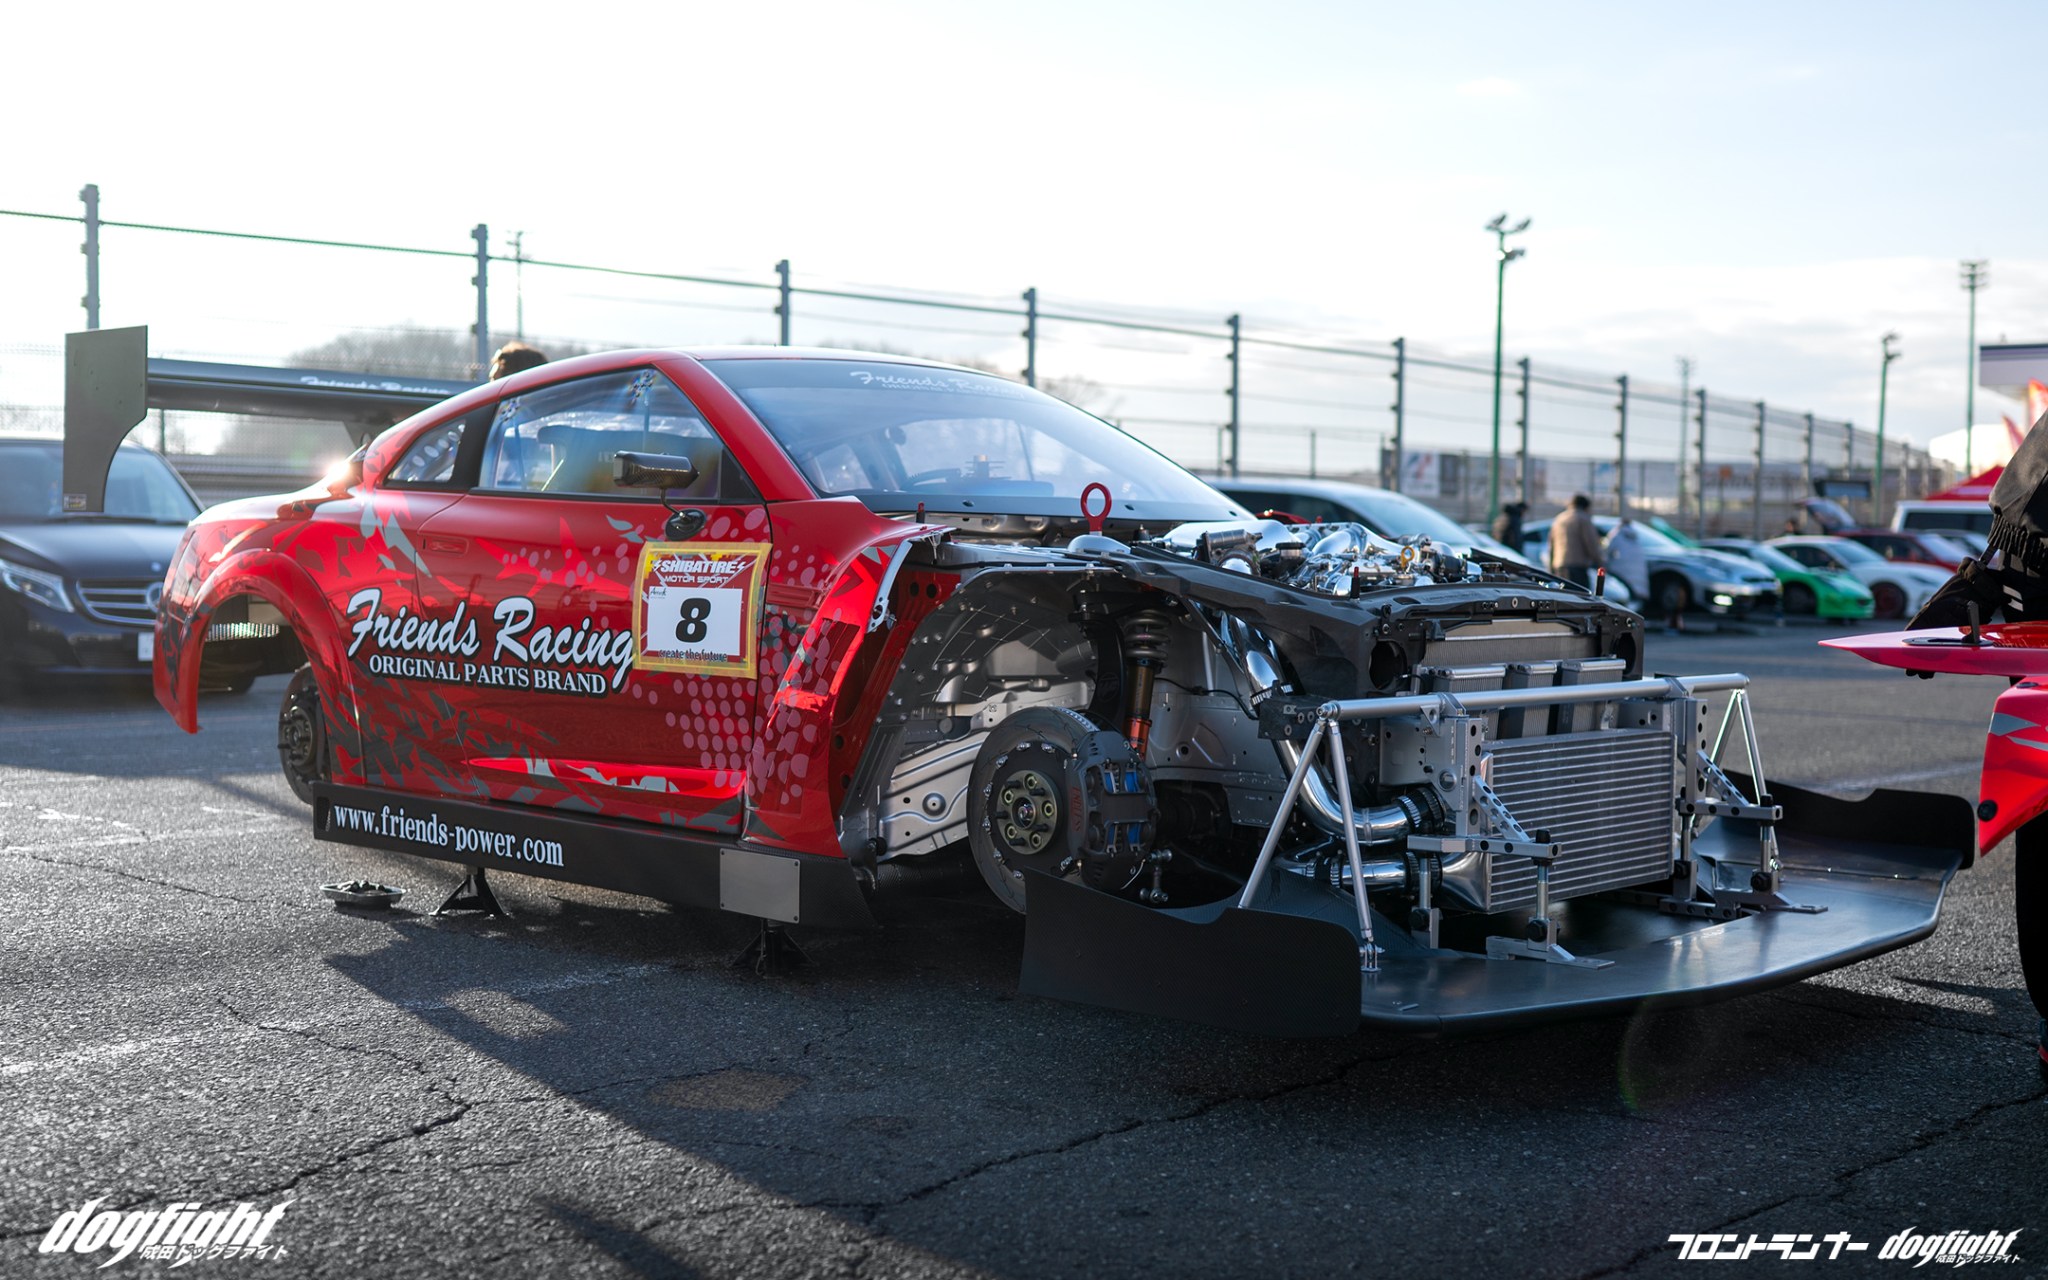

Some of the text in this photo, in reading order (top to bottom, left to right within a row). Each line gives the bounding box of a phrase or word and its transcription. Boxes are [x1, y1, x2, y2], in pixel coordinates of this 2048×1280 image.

[850, 371, 948, 391] Friends
[661, 559, 738, 574] SHIBATIRE
[664, 575, 729, 584] MOTOR SPORT
[675, 597, 711, 643] 8
[346, 587, 636, 690] Friends Racing
[659, 648, 727, 662] create the future
[369, 654, 607, 695] ORIGINAL PARTS BRAND
[334, 804, 565, 867] www.friends-power.com
